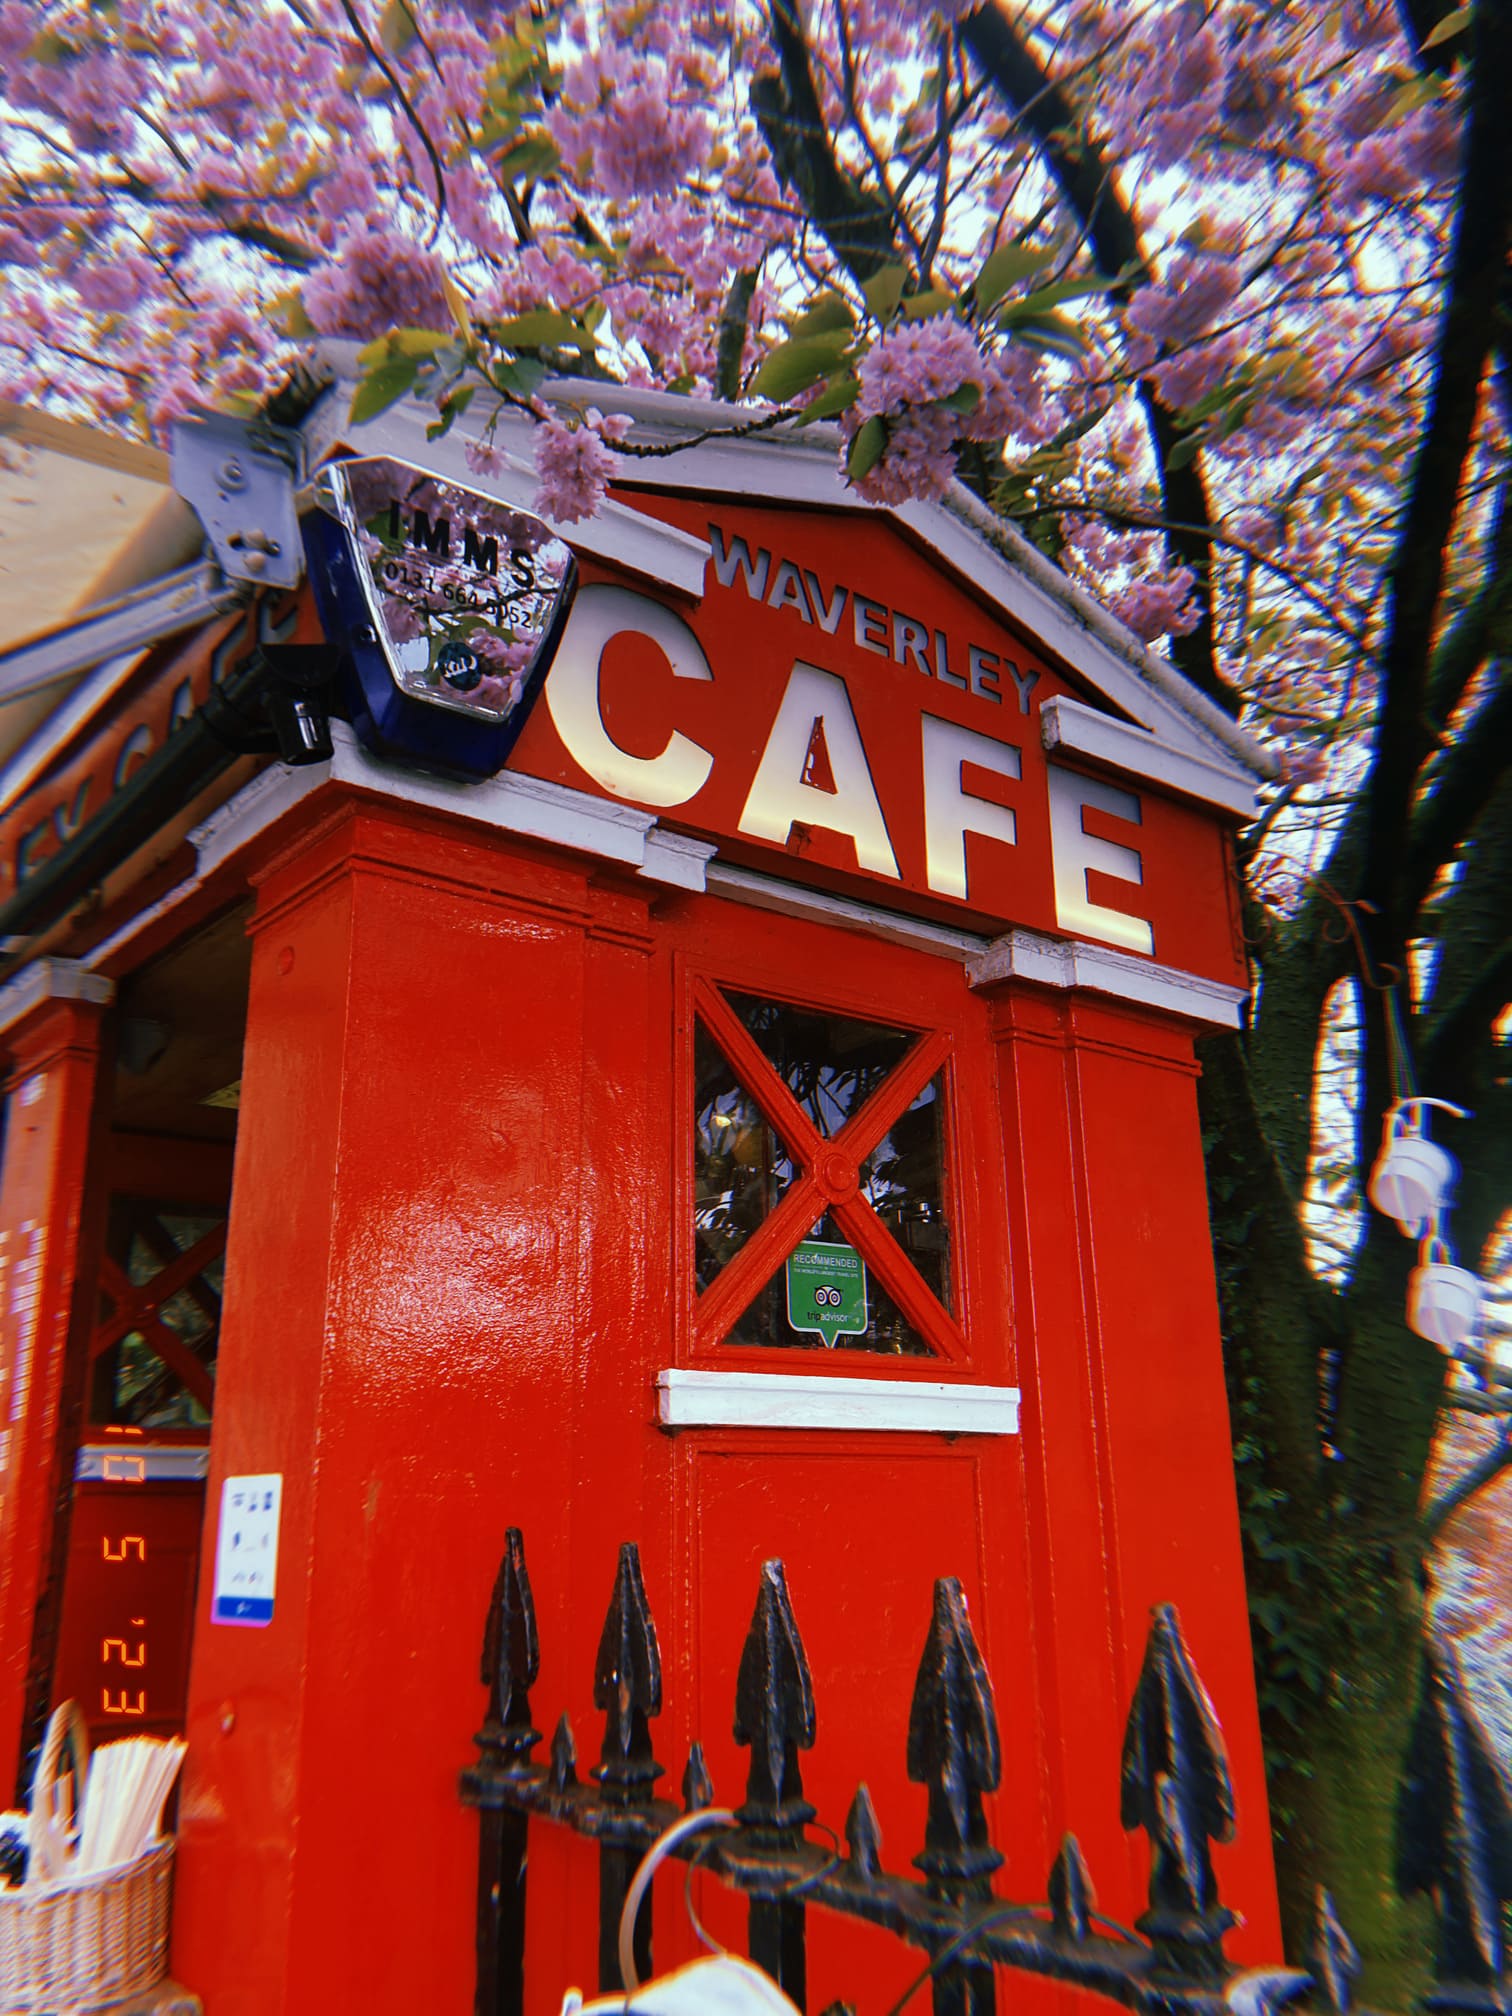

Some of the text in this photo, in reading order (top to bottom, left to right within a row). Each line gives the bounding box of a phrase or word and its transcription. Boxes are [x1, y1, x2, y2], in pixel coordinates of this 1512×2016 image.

[389, 500, 535, 588] IMMS
[385, 562, 435, 594] 0131
[708, 522, 1041, 714] WAVERLEY
[546, 583, 1155, 956] CAFE
[793, 1254, 858, 1268] RECOMMENDED
[807, 1311, 849, 1322] tripadvisor
